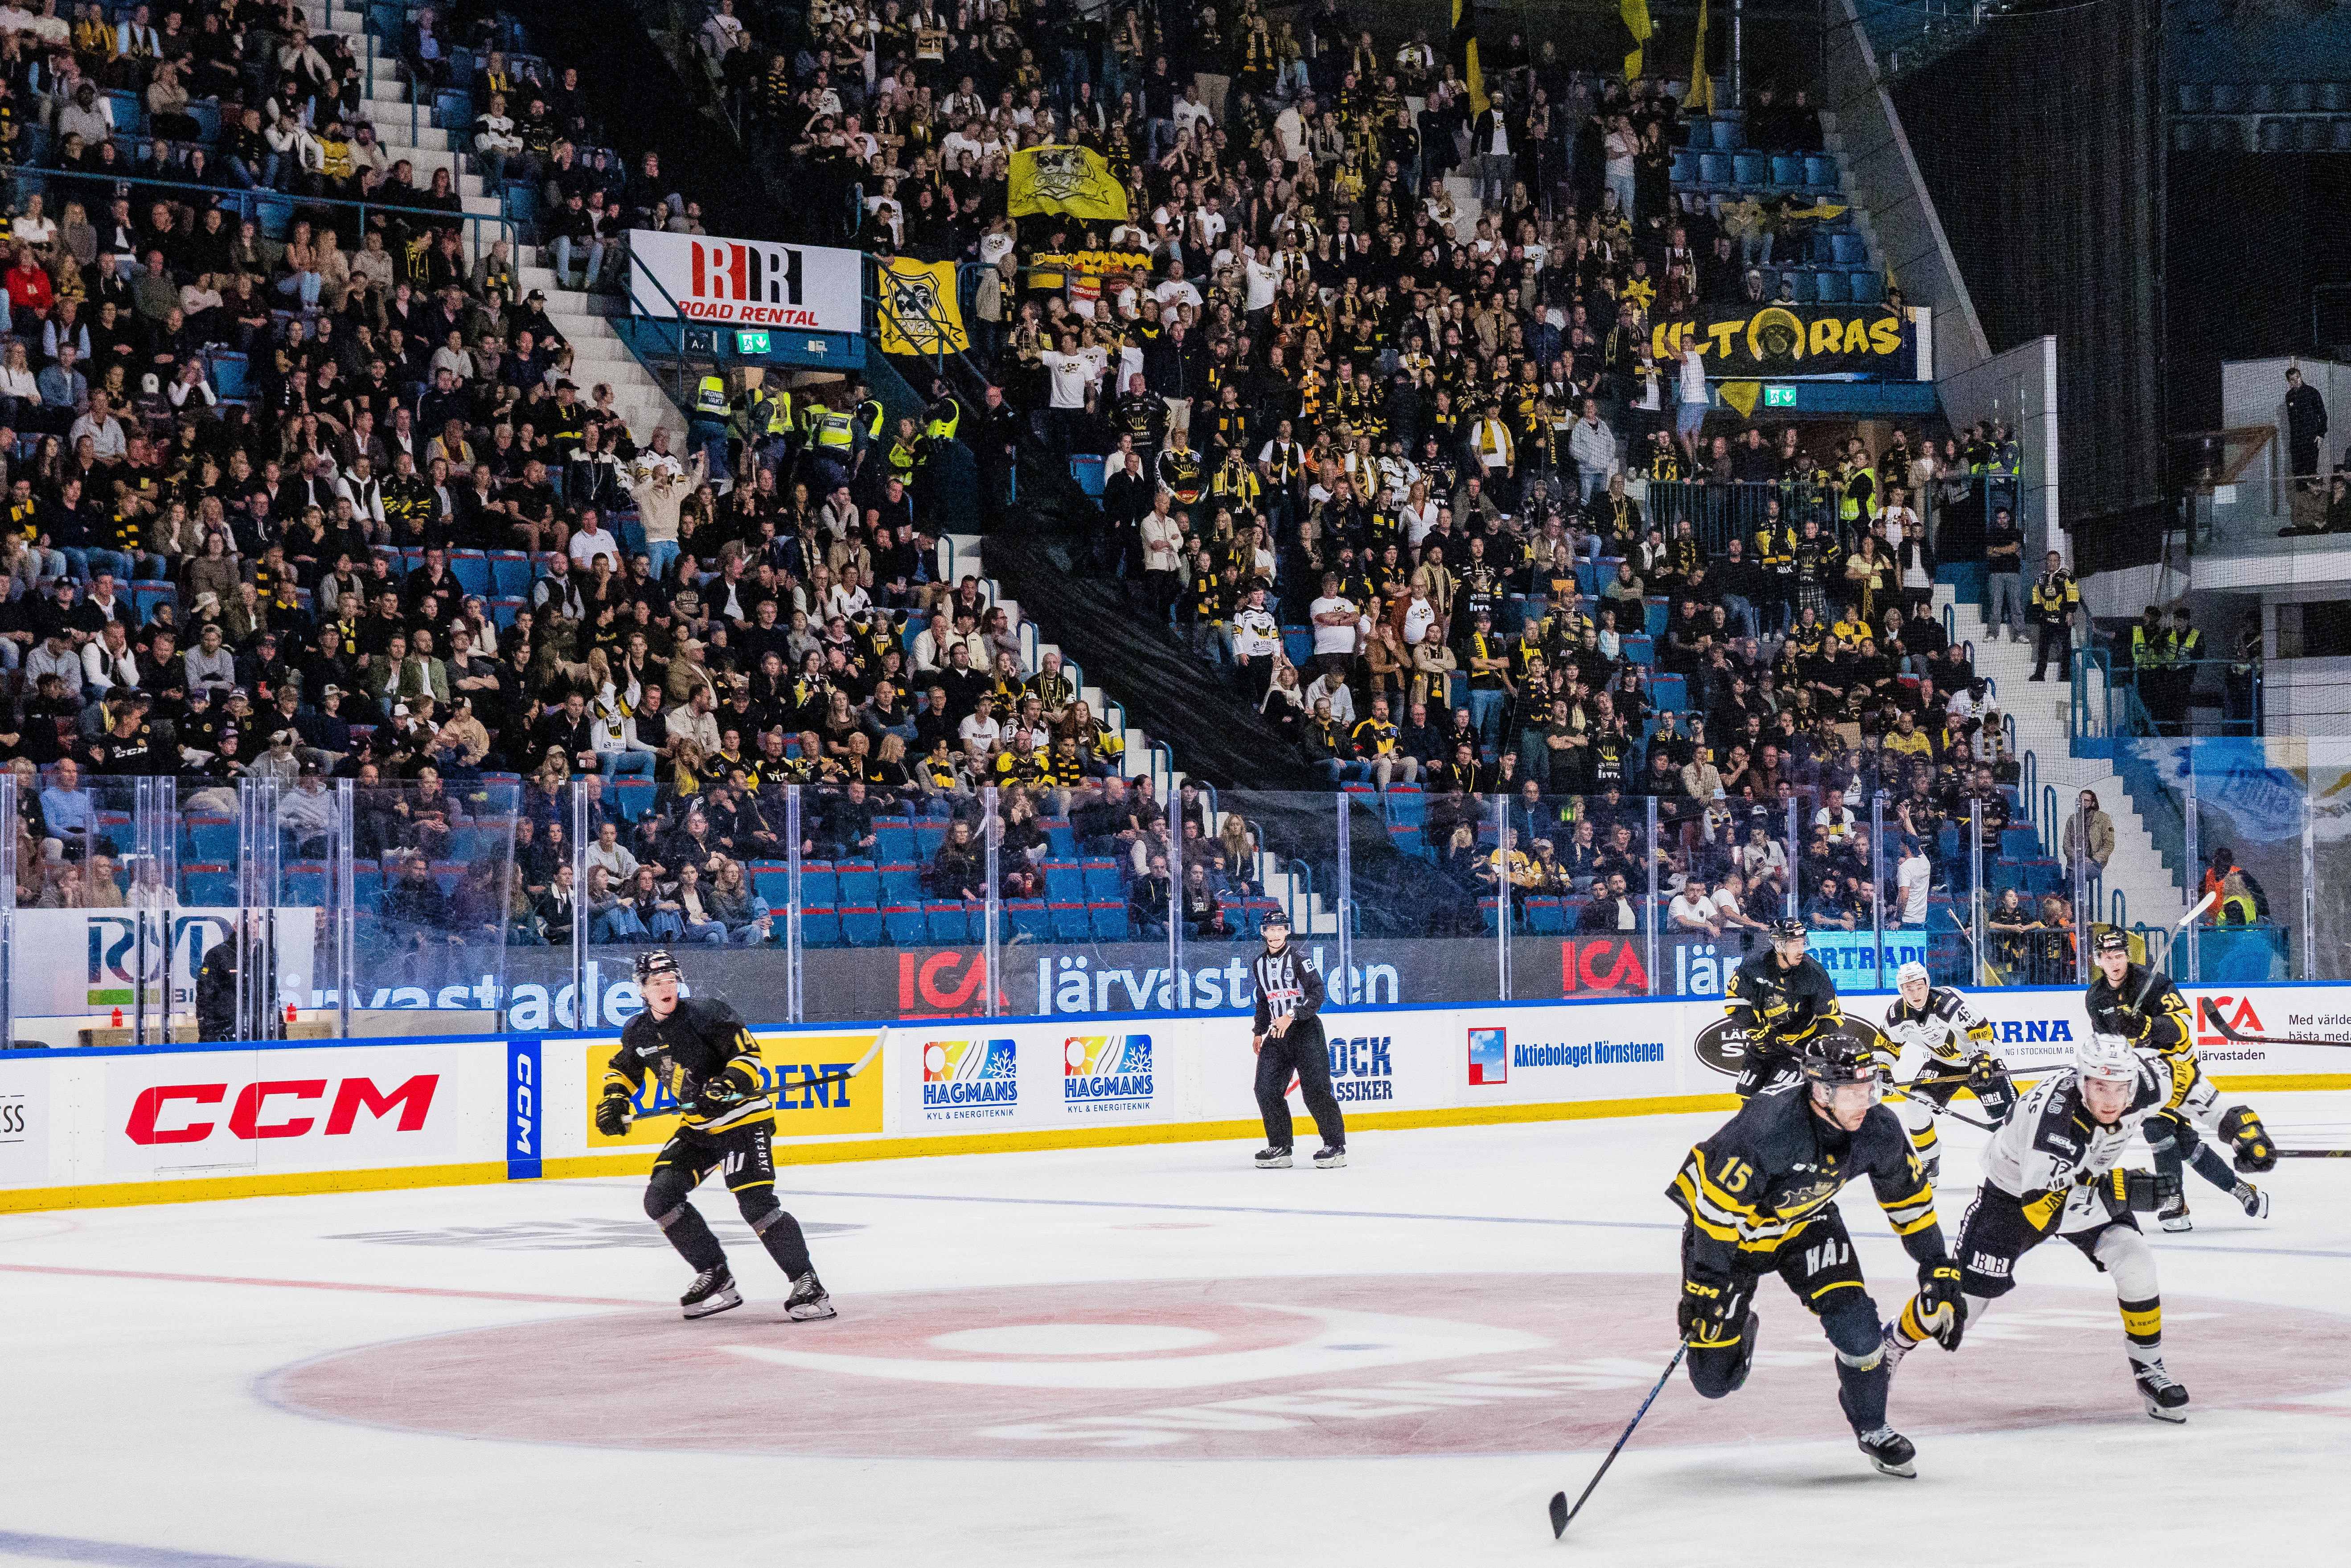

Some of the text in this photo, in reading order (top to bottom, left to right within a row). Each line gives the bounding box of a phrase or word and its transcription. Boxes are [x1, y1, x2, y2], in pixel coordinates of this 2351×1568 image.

[678, 301, 819, 326] ROAD RENTAL
[1563, 940, 1648, 990] ICA
[899, 951, 1010, 1008] ICA
[1957, 1006, 1971, 1023] 46
[2161, 993, 2183, 1012] 58
[2197, 996, 2265, 1032] ICA
[2289, 1014, 2313, 1025] Med
[735, 1028, 758, 1053] 14
[2021, 1047, 2063, 1055] STOCKHOLM
[1328, 1036, 1392, 1078] OCK
[1514, 1040, 1664, 1067] Aktiebolaget Hörnstenen
[2198, 1049, 2265, 1063] Järvastaden
[923, 1081, 1018, 1104] HAGMANS
[1065, 1075, 1153, 1098] HAGMANS
[125, 1075, 440, 1145] CCM
[517, 1054, 531, 1155] CCM
[927, 1108, 1014, 1120] KYL & ENERGITEKNIK
[1068, 1102, 1150, 1113] KYL & ENERGITEKNIK
[0, 1104, 25, 1133] SS
[1716, 1157, 1753, 1193] 15
[1805, 1238, 1849, 1276] HÅJ
